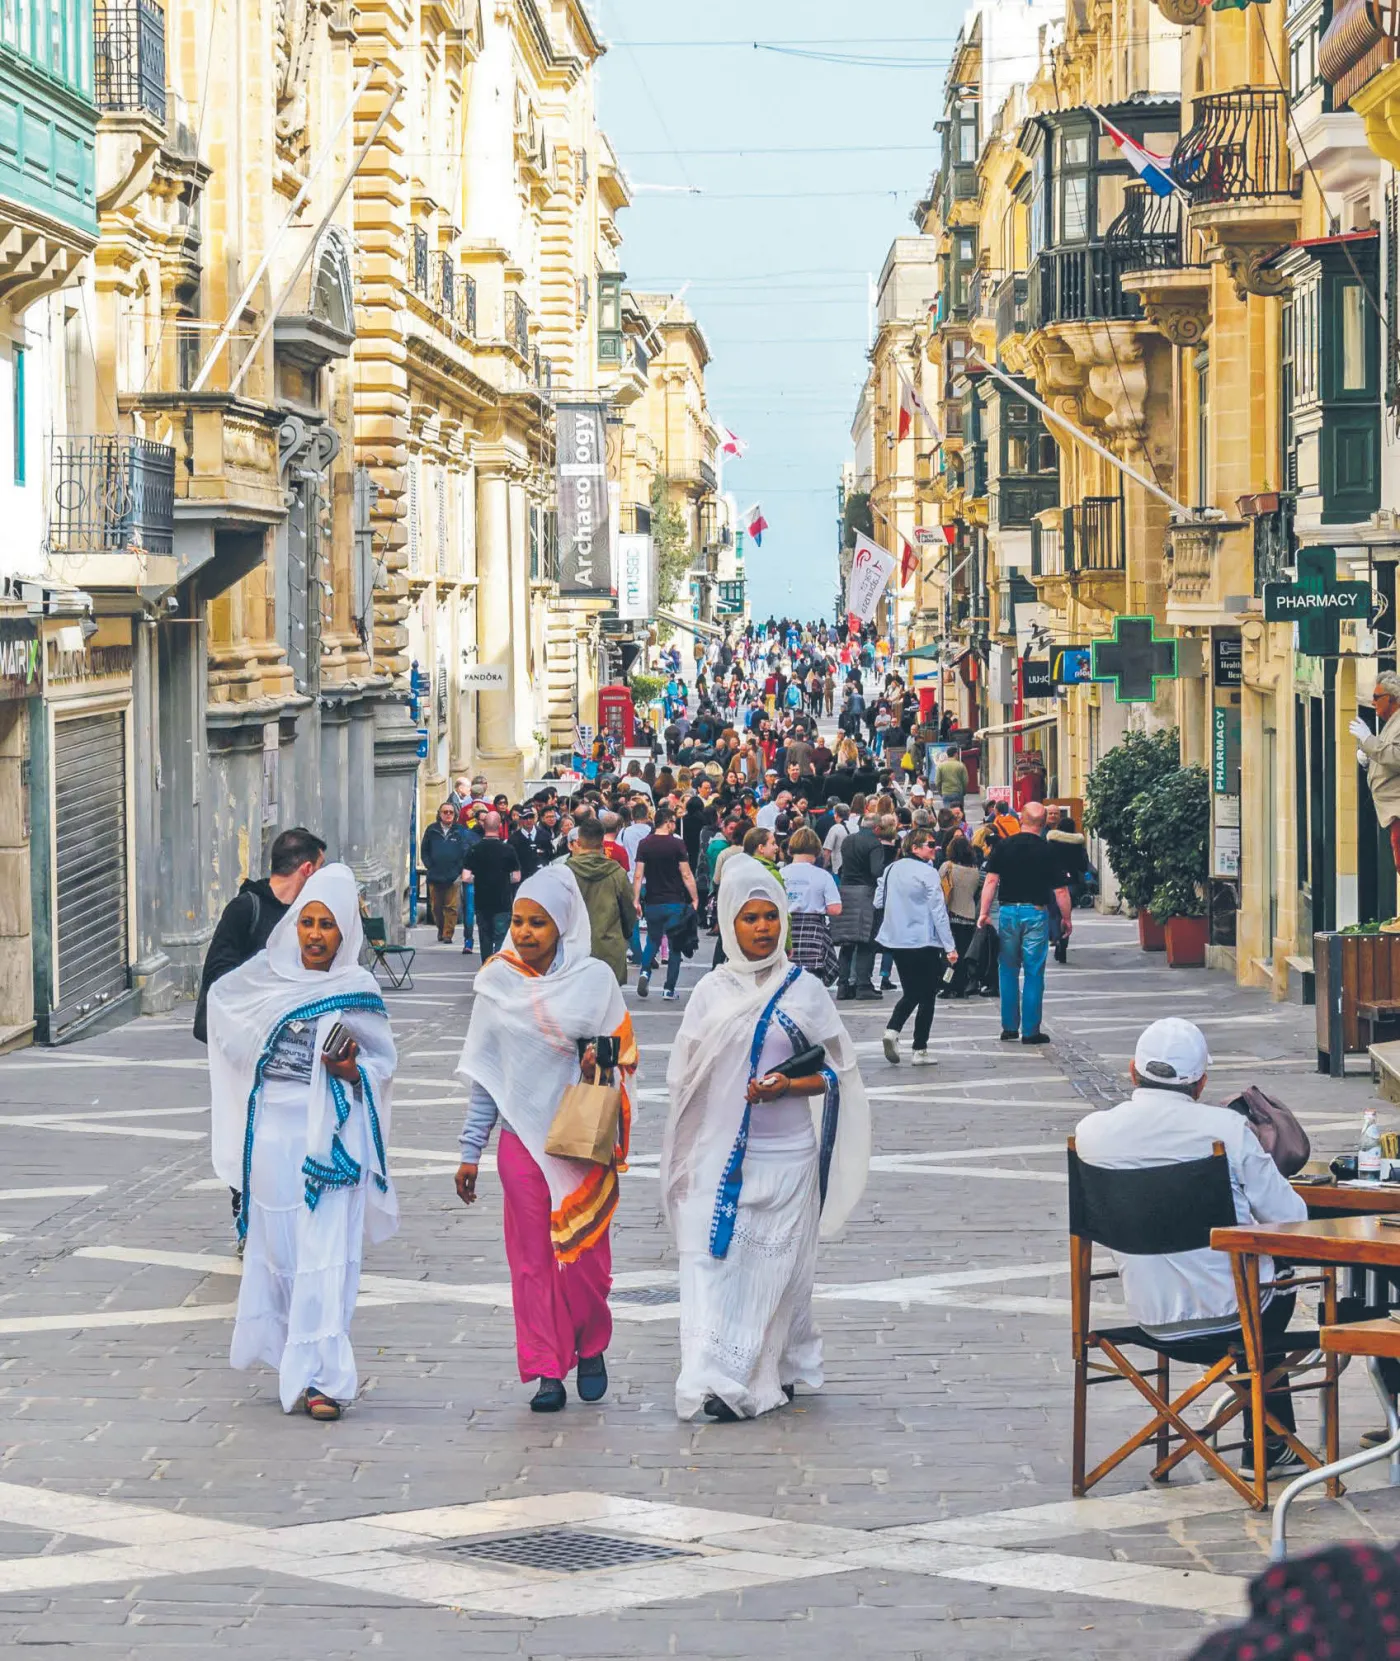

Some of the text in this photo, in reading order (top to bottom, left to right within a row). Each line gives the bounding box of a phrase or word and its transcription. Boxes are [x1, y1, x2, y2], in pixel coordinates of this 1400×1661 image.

[566, 413, 600, 588] Archaeology
[1276, 593, 1358, 609] PHARMACY
[1216, 711, 1225, 790] PHARMACY
